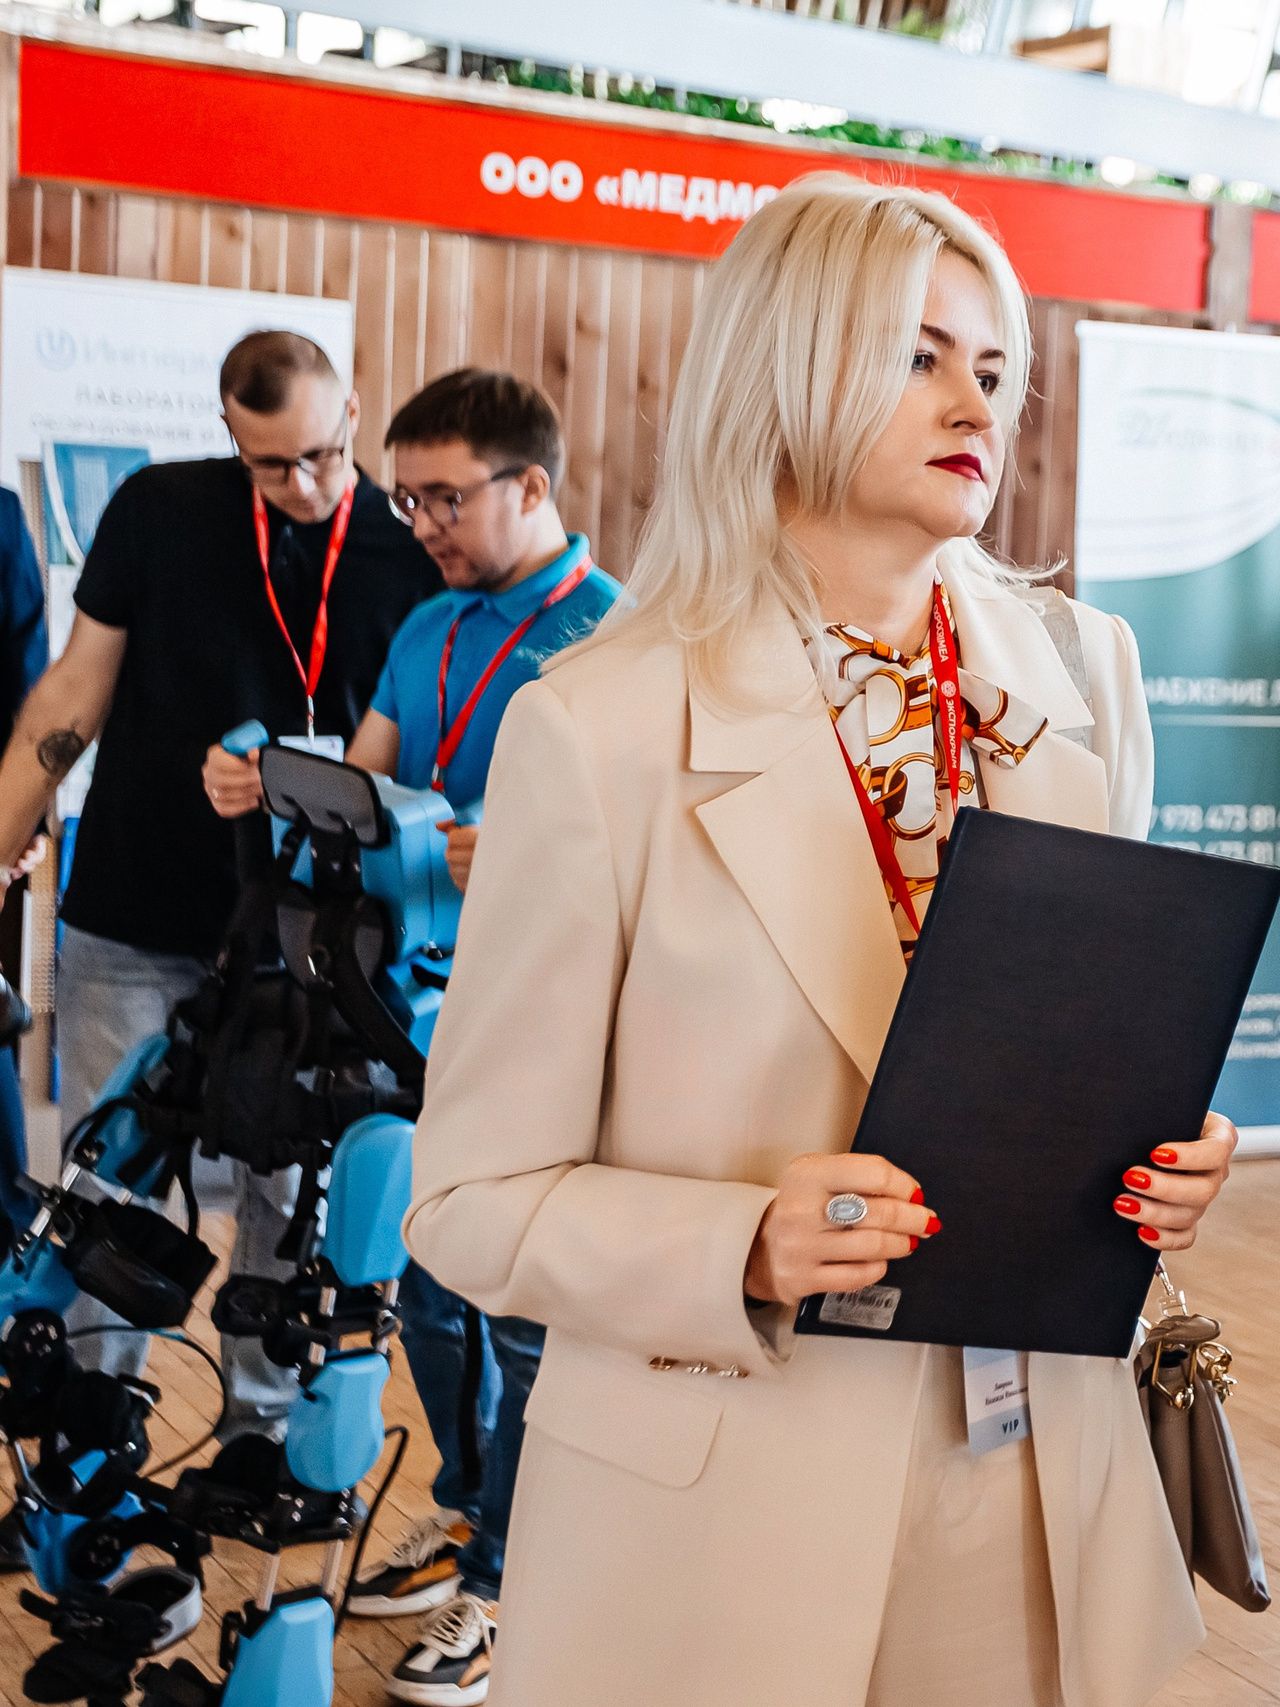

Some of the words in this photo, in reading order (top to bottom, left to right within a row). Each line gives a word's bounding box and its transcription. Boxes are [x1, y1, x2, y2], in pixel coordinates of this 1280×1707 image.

[481, 152, 583, 202] ООО
[946, 699, 957, 769] ЭКСПОКРЫМ
[1002, 1418, 1020, 1434] VIP
